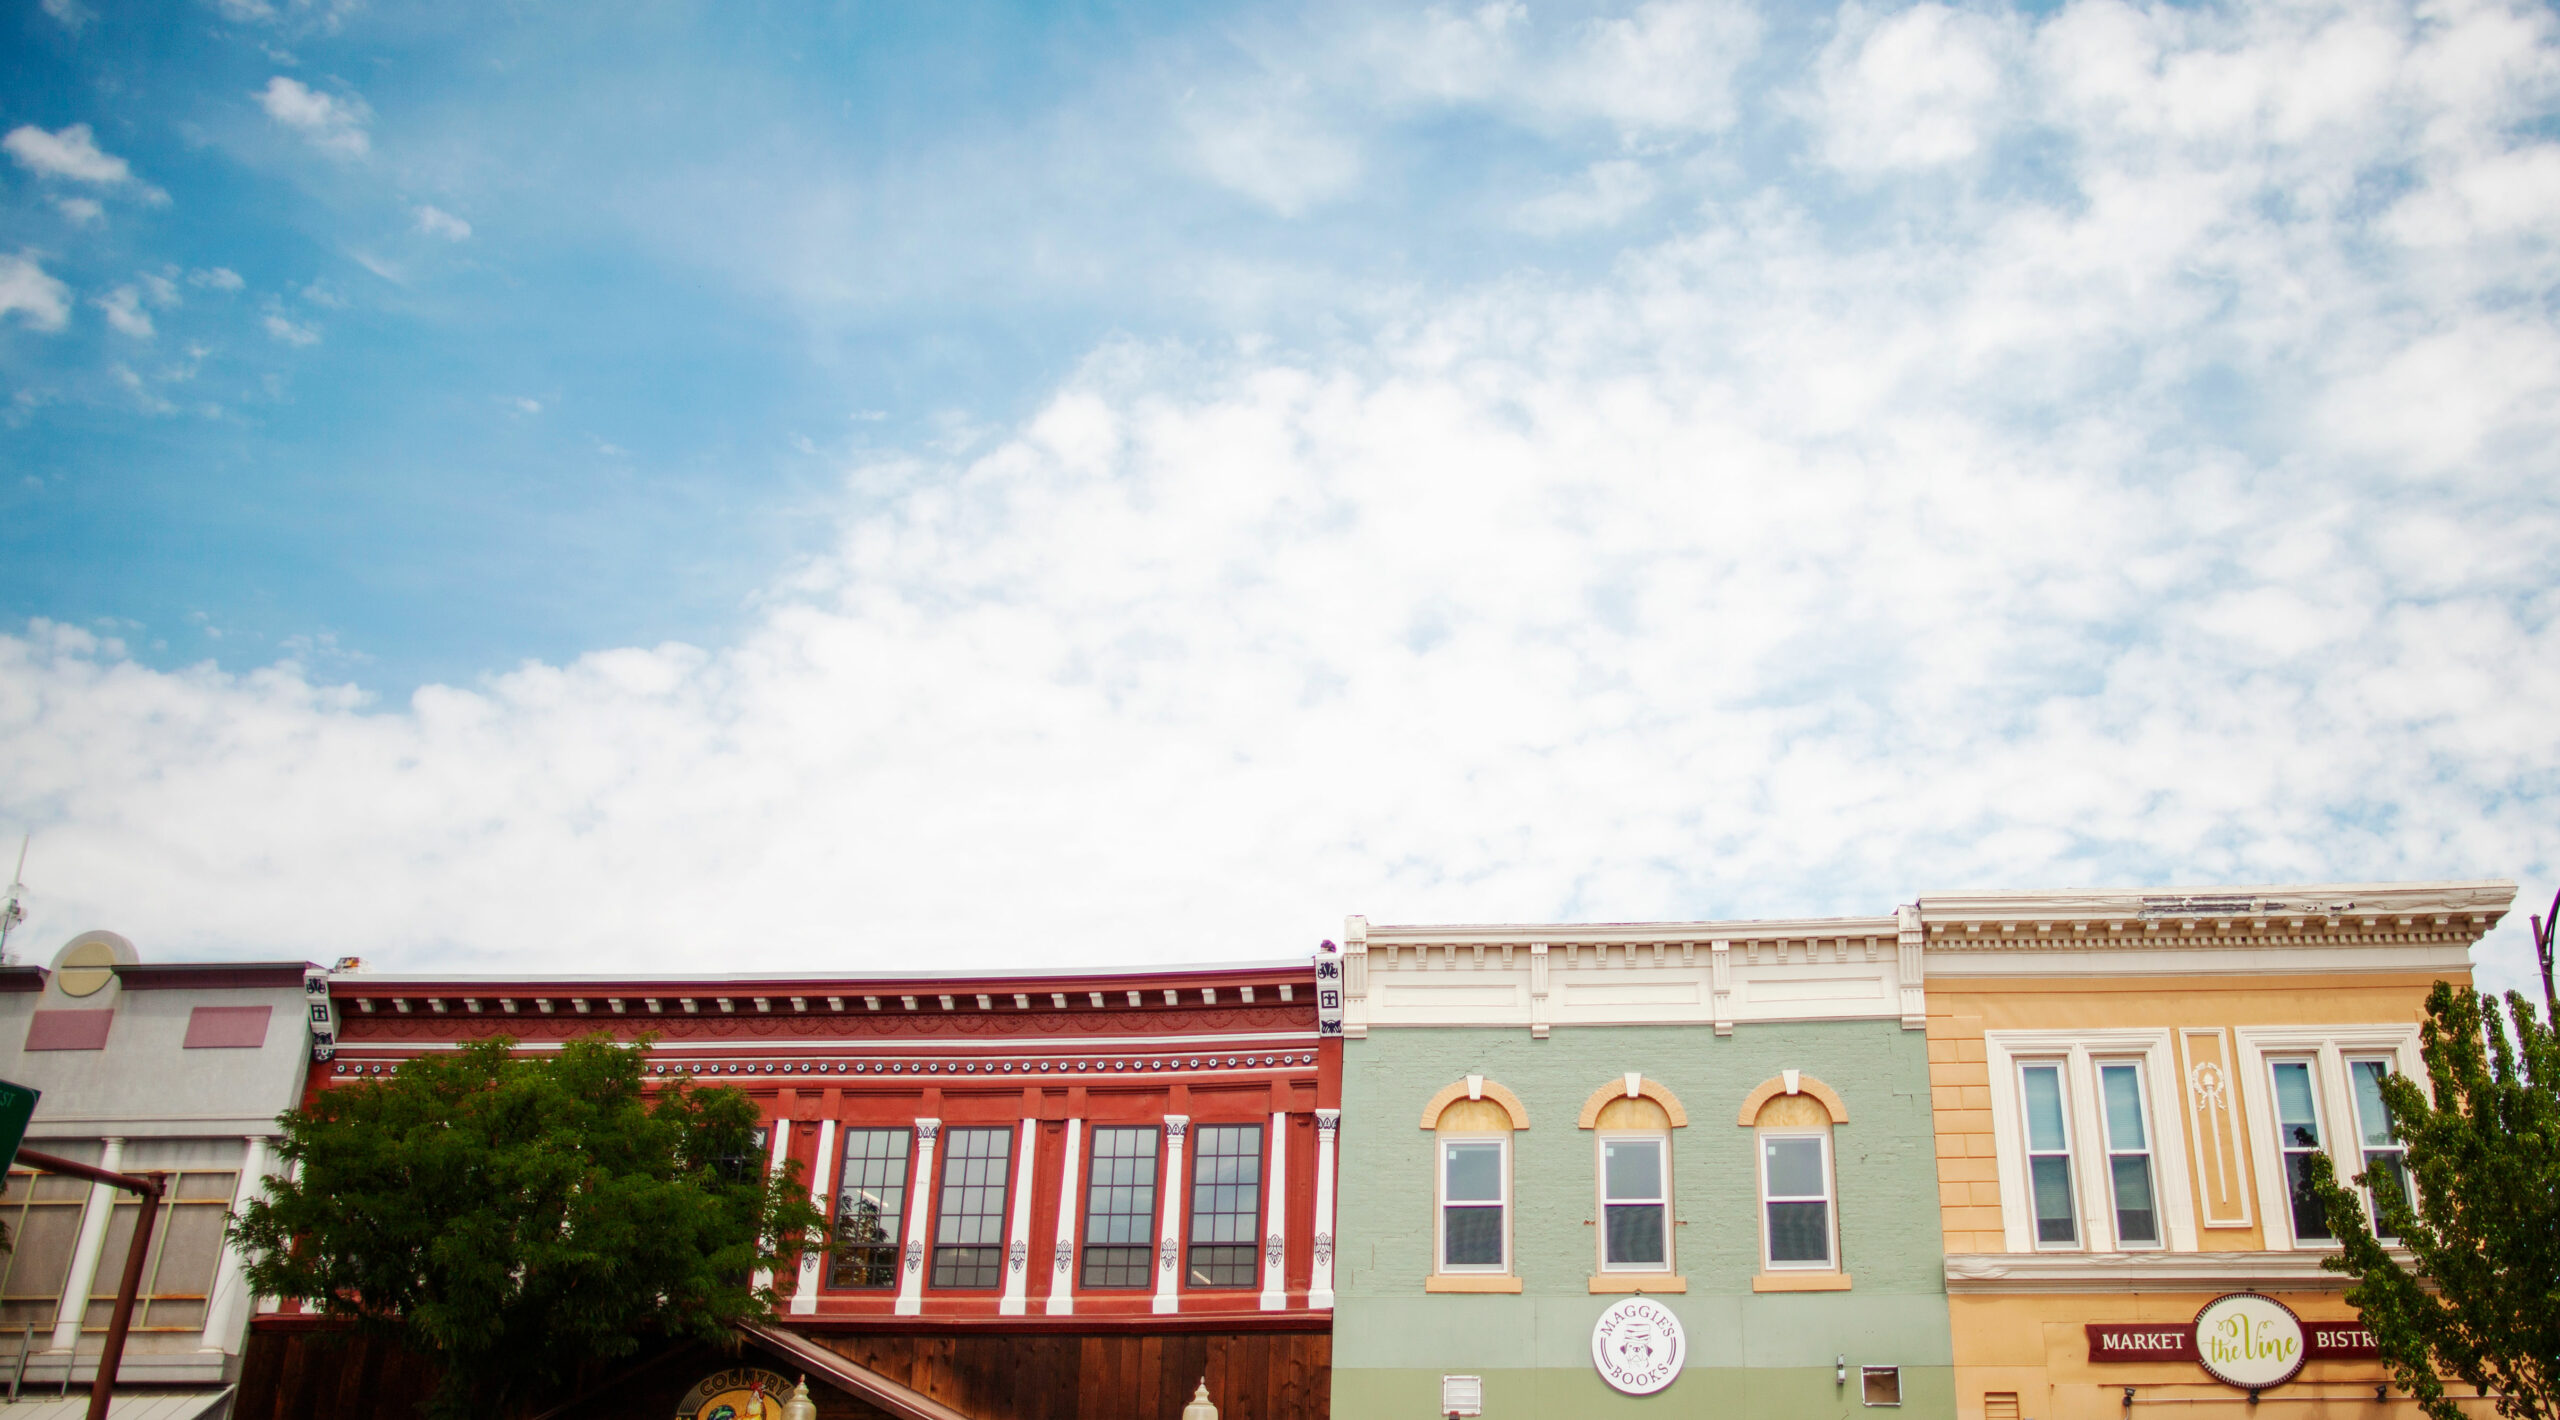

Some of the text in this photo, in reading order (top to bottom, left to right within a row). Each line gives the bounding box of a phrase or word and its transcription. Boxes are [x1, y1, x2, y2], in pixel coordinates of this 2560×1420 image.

[1600, 1305, 1674, 1337] MAGGIE'S
[2102, 1333, 2184, 1350] MARKET
[2202, 1313, 2299, 1363] the Vine
[700, 1369, 791, 1396] COUNTRY
[1611, 1363, 1669, 1386] BOOKS
